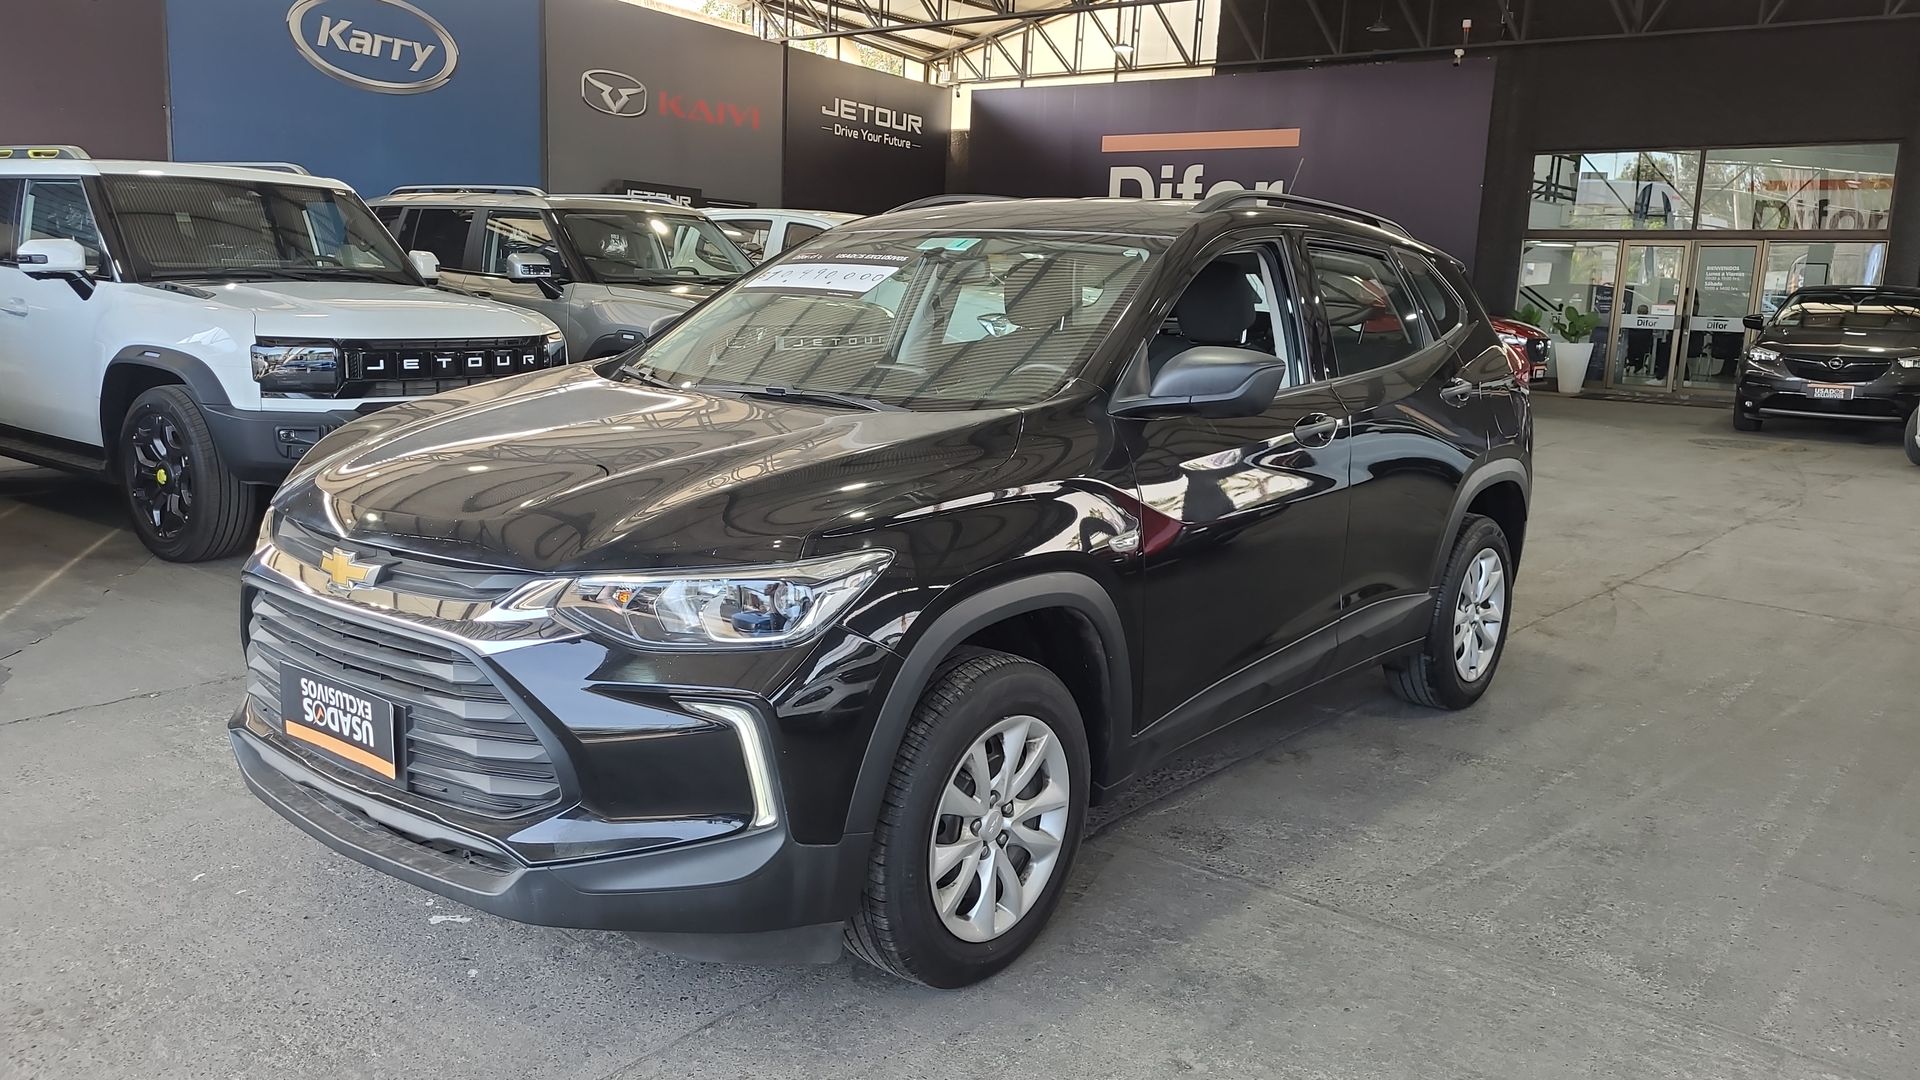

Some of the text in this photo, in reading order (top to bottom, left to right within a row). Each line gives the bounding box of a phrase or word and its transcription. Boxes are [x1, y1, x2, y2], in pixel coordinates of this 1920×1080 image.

[317, 16, 436, 72] Karry
[658, 91, 759, 129] KAIYI
[821, 97, 923, 135] JETOUR
[834, 123, 911, 149] Drive Your Future
[1108, 164, 1285, 207] Difor
[1636, 319, 1657, 327] Difor
[1706, 321, 1728, 330] Difor
[367, 354, 535, 371] JETOUR
[300, 677, 372, 721] EXCLUSIVOS
[302, 697, 375, 748] USADOS
